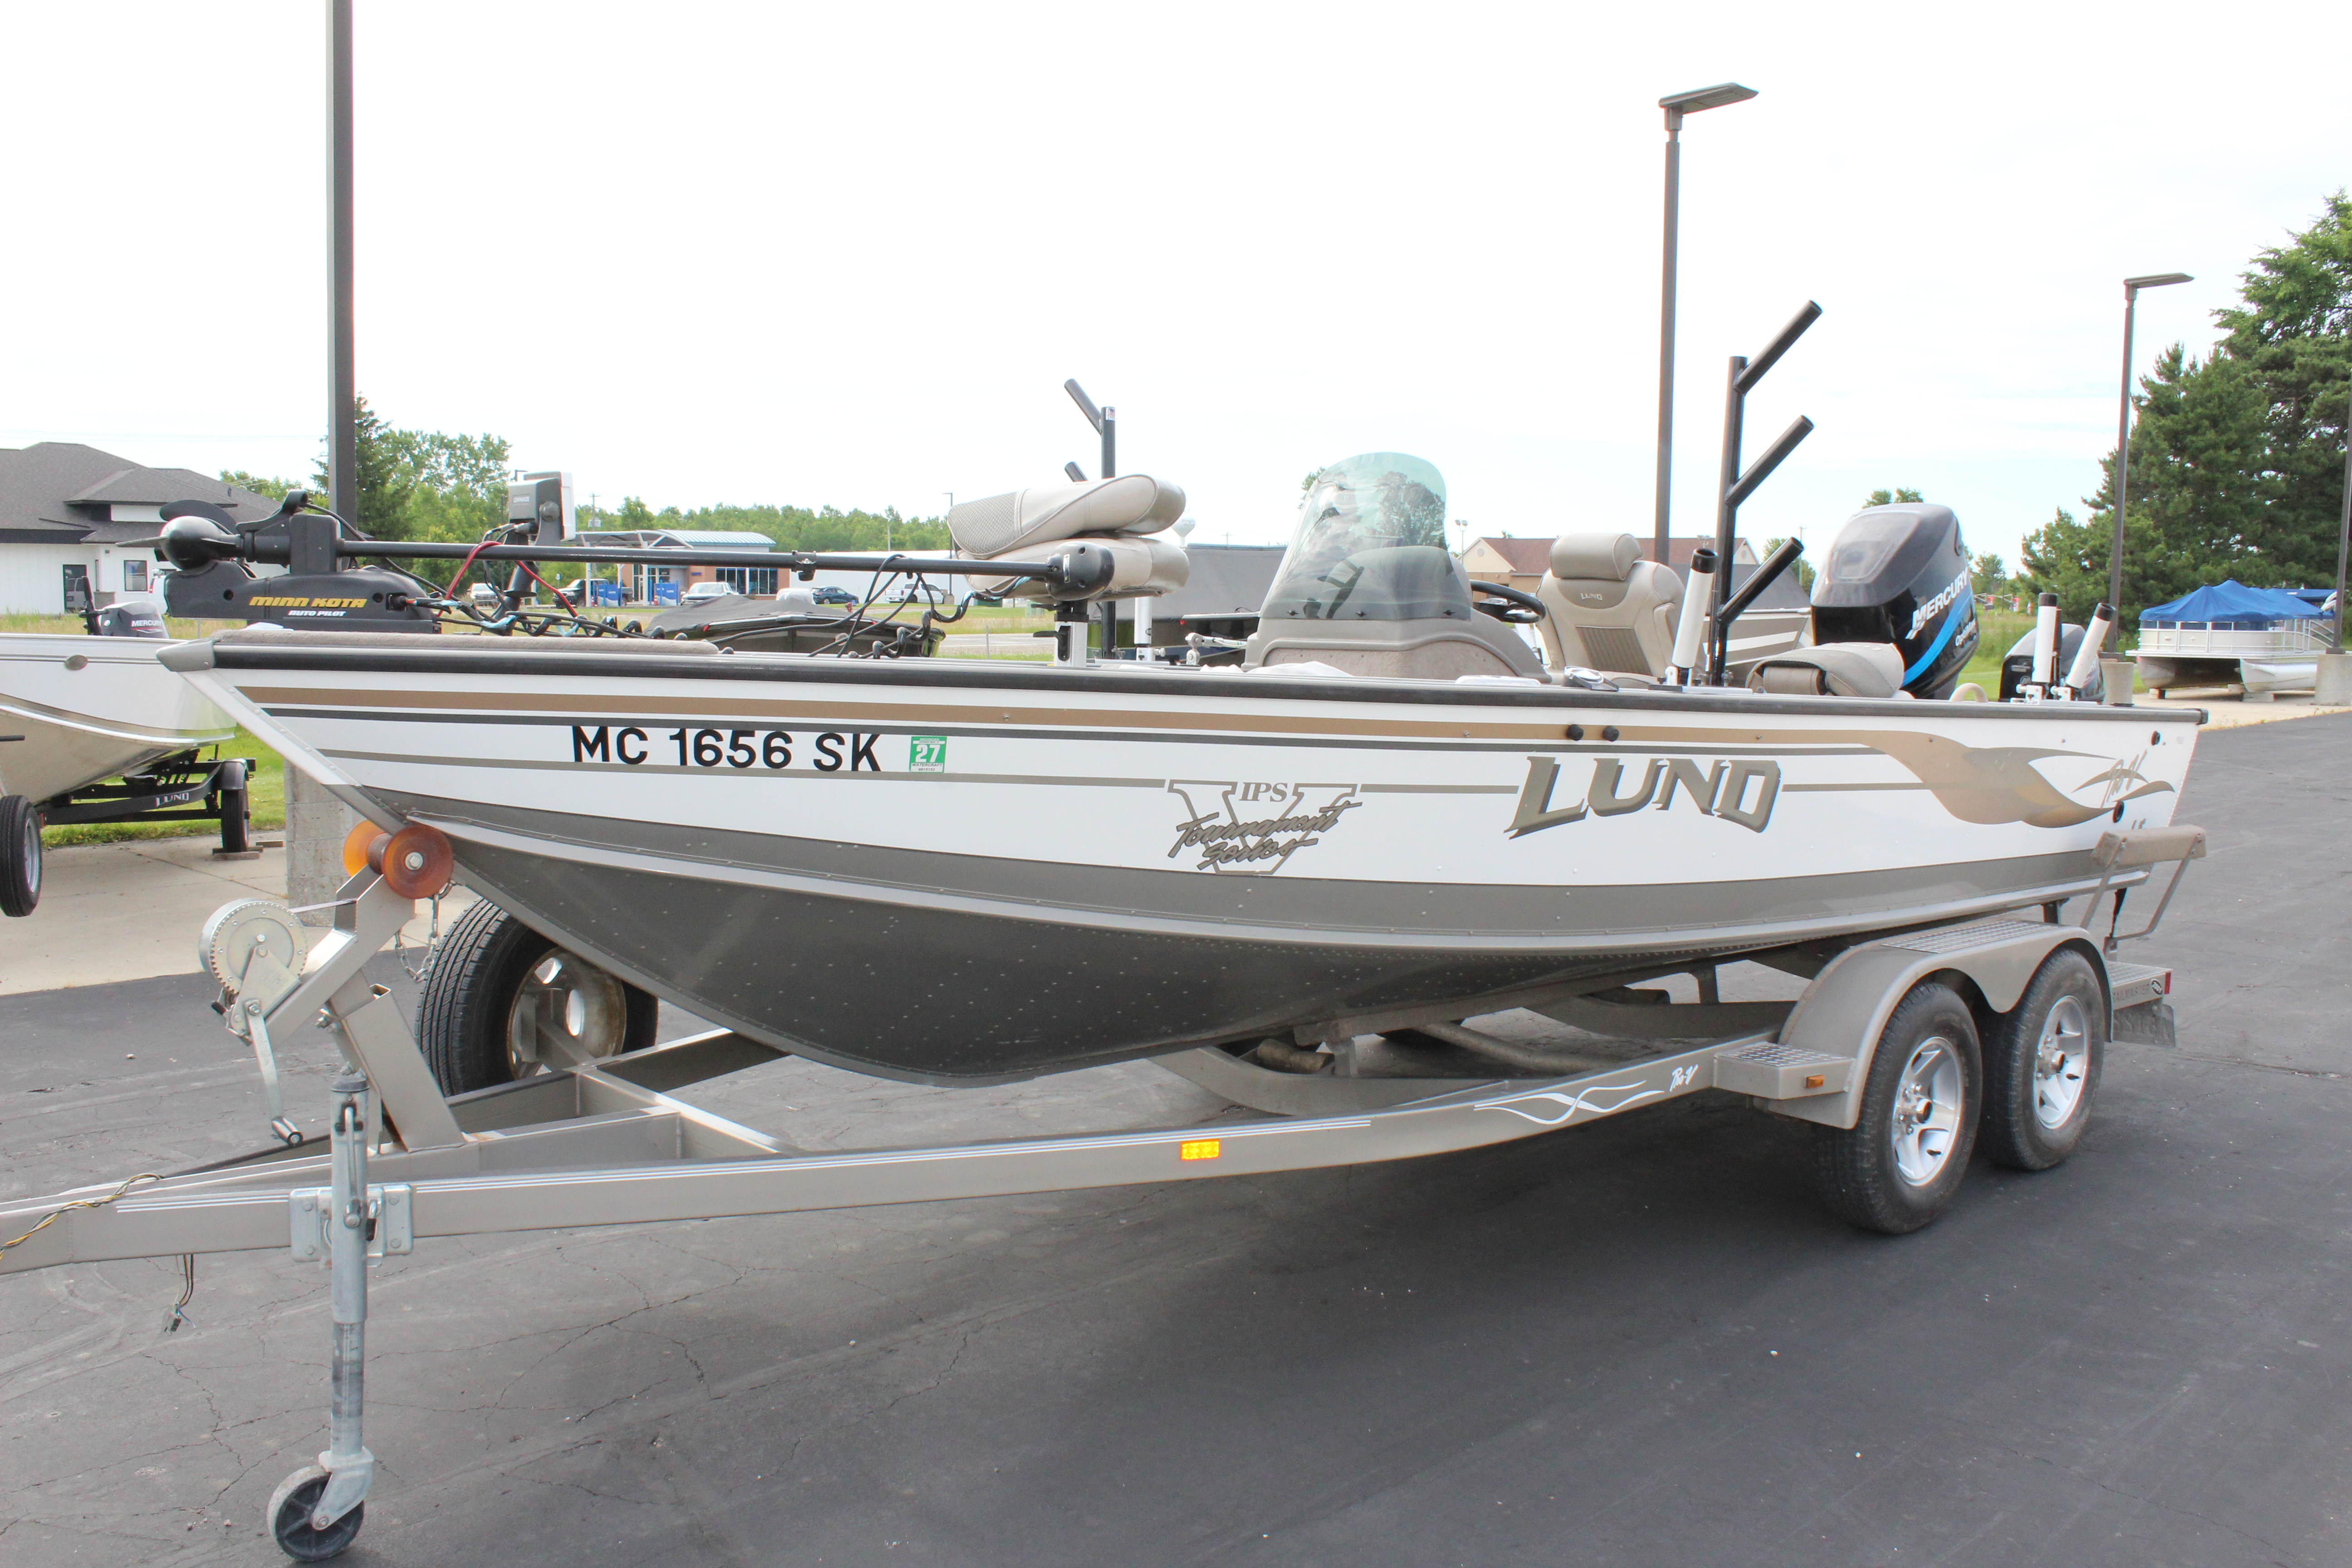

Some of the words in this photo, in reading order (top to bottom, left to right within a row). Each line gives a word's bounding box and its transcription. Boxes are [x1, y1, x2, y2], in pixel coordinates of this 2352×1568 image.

[249, 596, 310, 607] MINN
[311, 598, 368, 608] KOTA
[1905, 566, 1968, 639] MERCURY
[572, 726, 648, 765] MC
[670, 728, 792, 769] 1656
[813, 733, 881, 772] SK
[915, 745, 941, 763] 27
[155, 792, 189, 807] LUND
[1239, 782, 1288, 802] IPS
[1503, 755, 1782, 840] LUND
[1167, 800, 1362, 858] Tournament
[1196, 838, 1318, 871] Series
